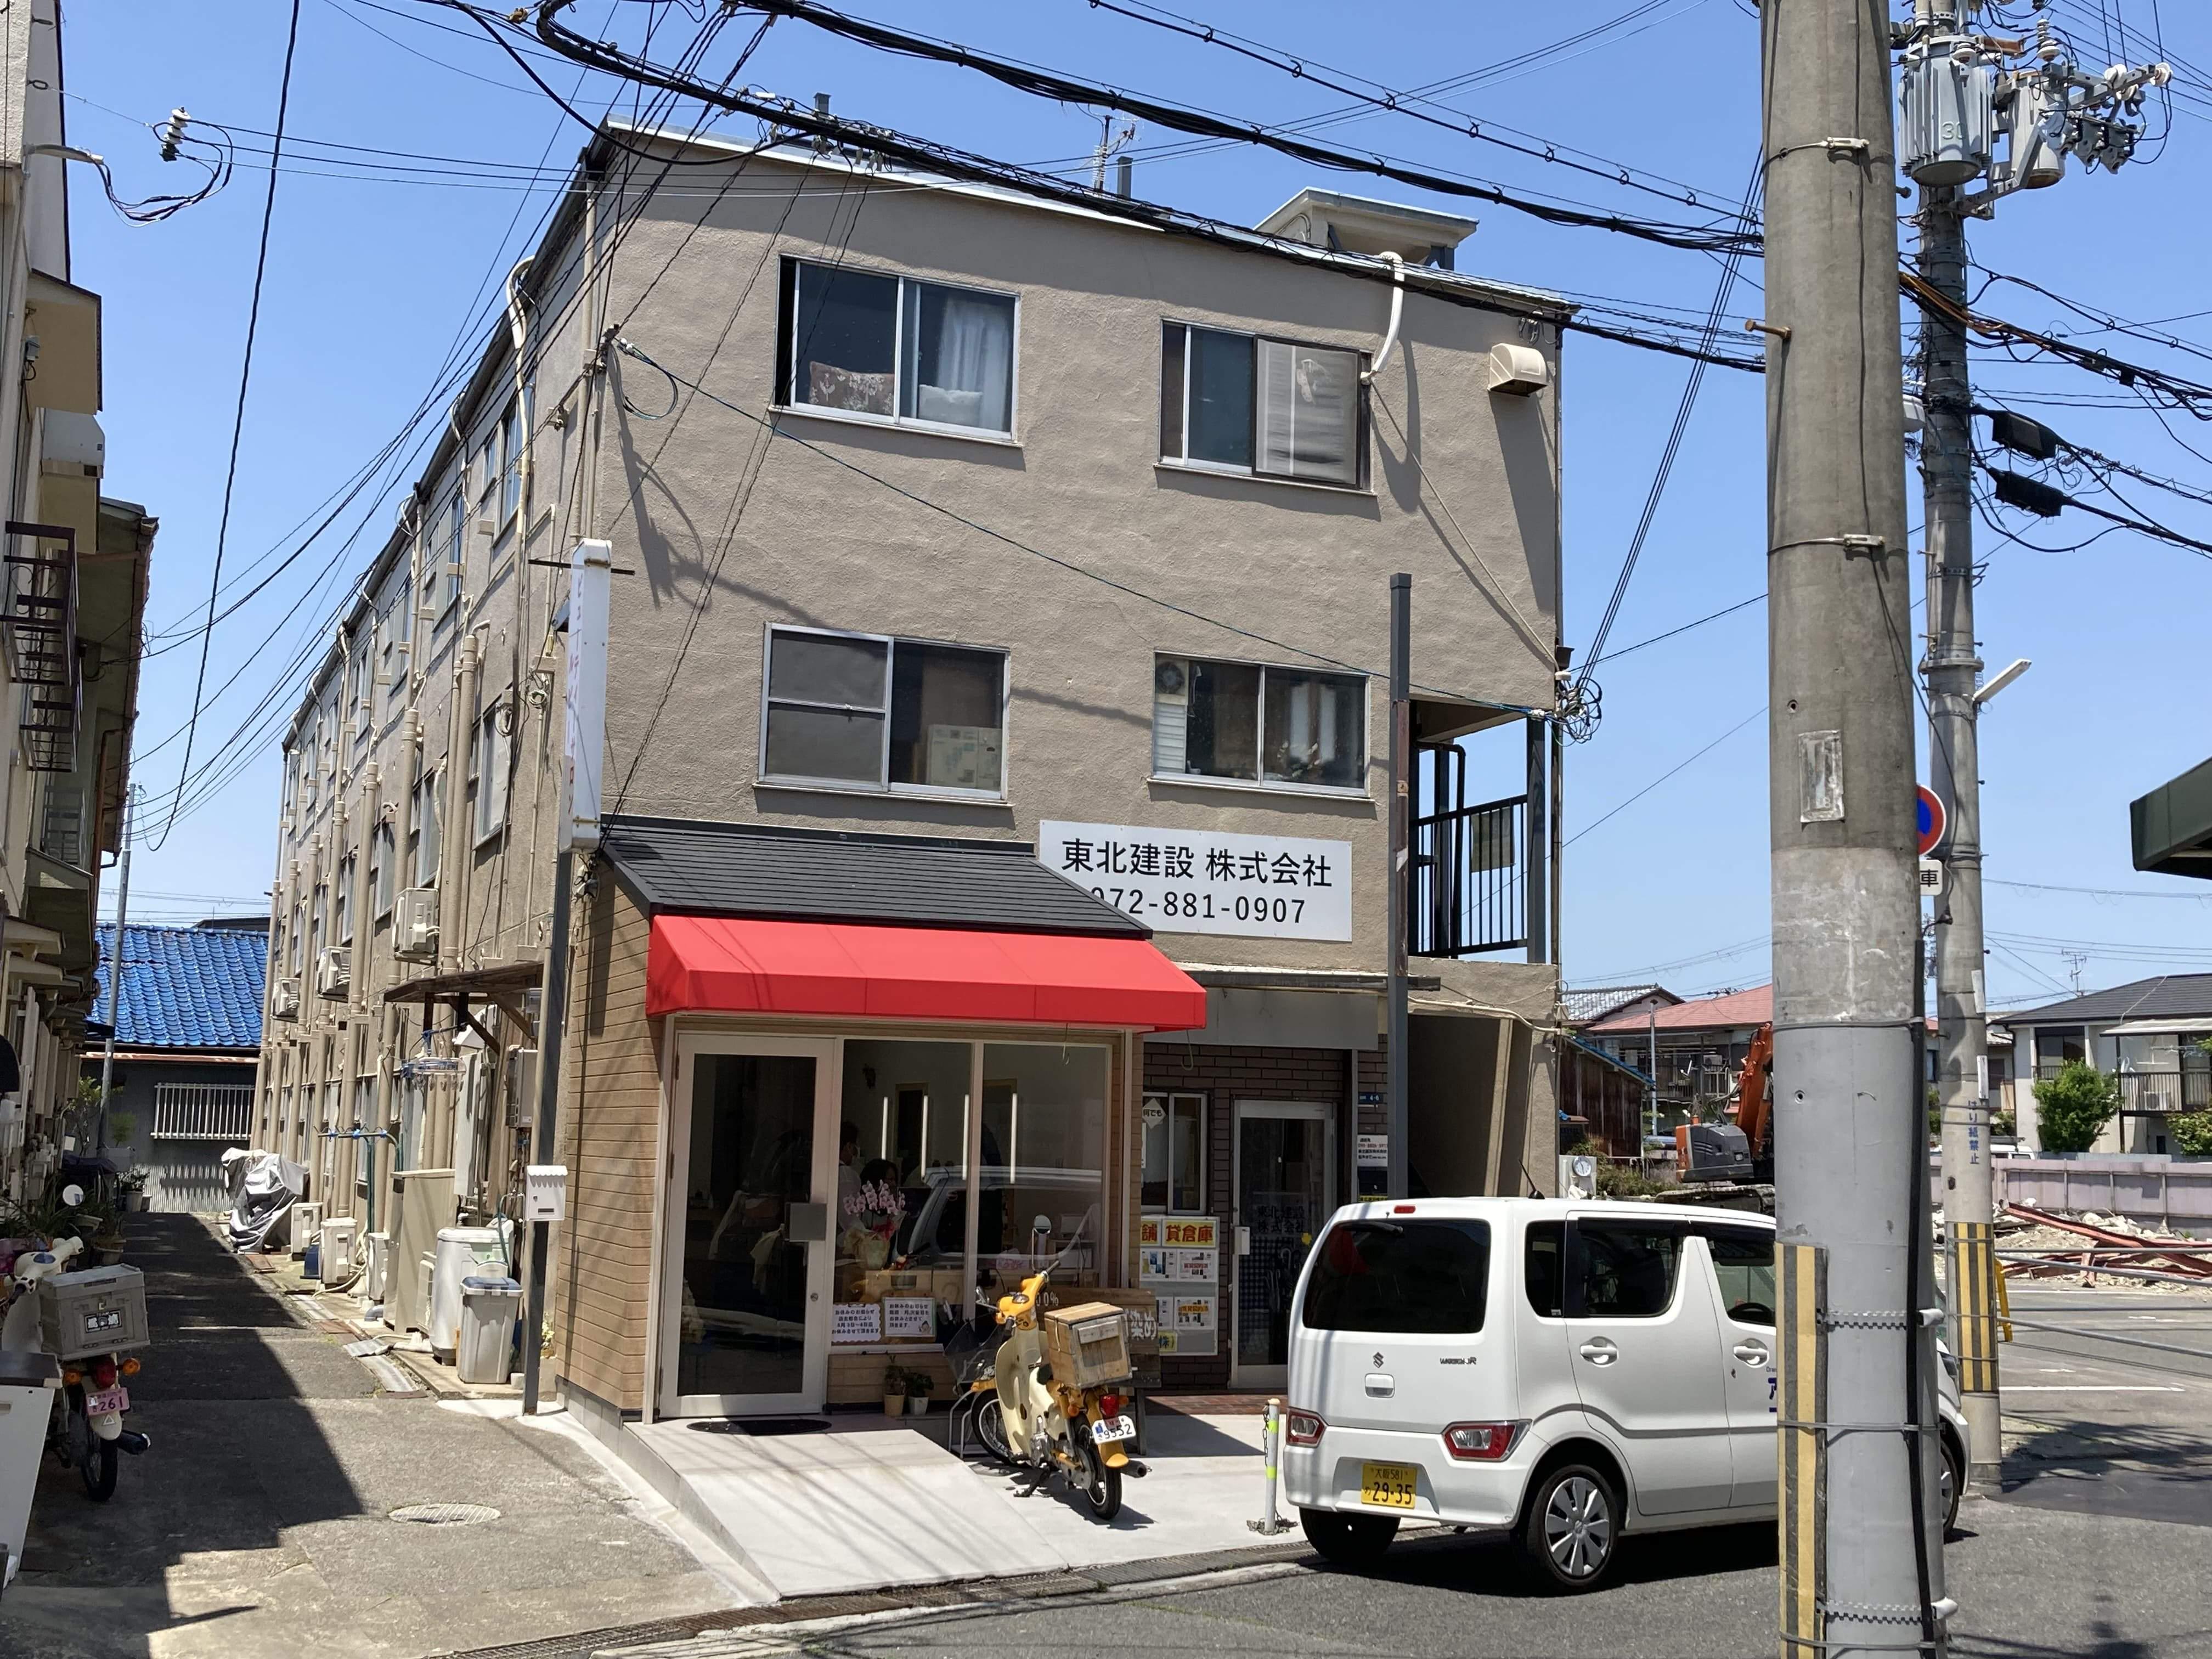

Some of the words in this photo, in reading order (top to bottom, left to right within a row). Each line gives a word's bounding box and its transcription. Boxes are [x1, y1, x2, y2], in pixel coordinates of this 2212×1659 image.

[1062, 838, 1194, 879] 東北建設
[1206, 848, 1333, 887] 株式会社
[1920, 869, 1939, 887] 車
[1143, 1109, 1163, 1117] 何でも
[1968, 1099, 1980, 1165] はり紙禁止
[1166, 1224, 1214, 1242] 貸倉庫
[99, 1396, 123, 1412] 261
[1103, 1424, 1133, 1439] 9552
